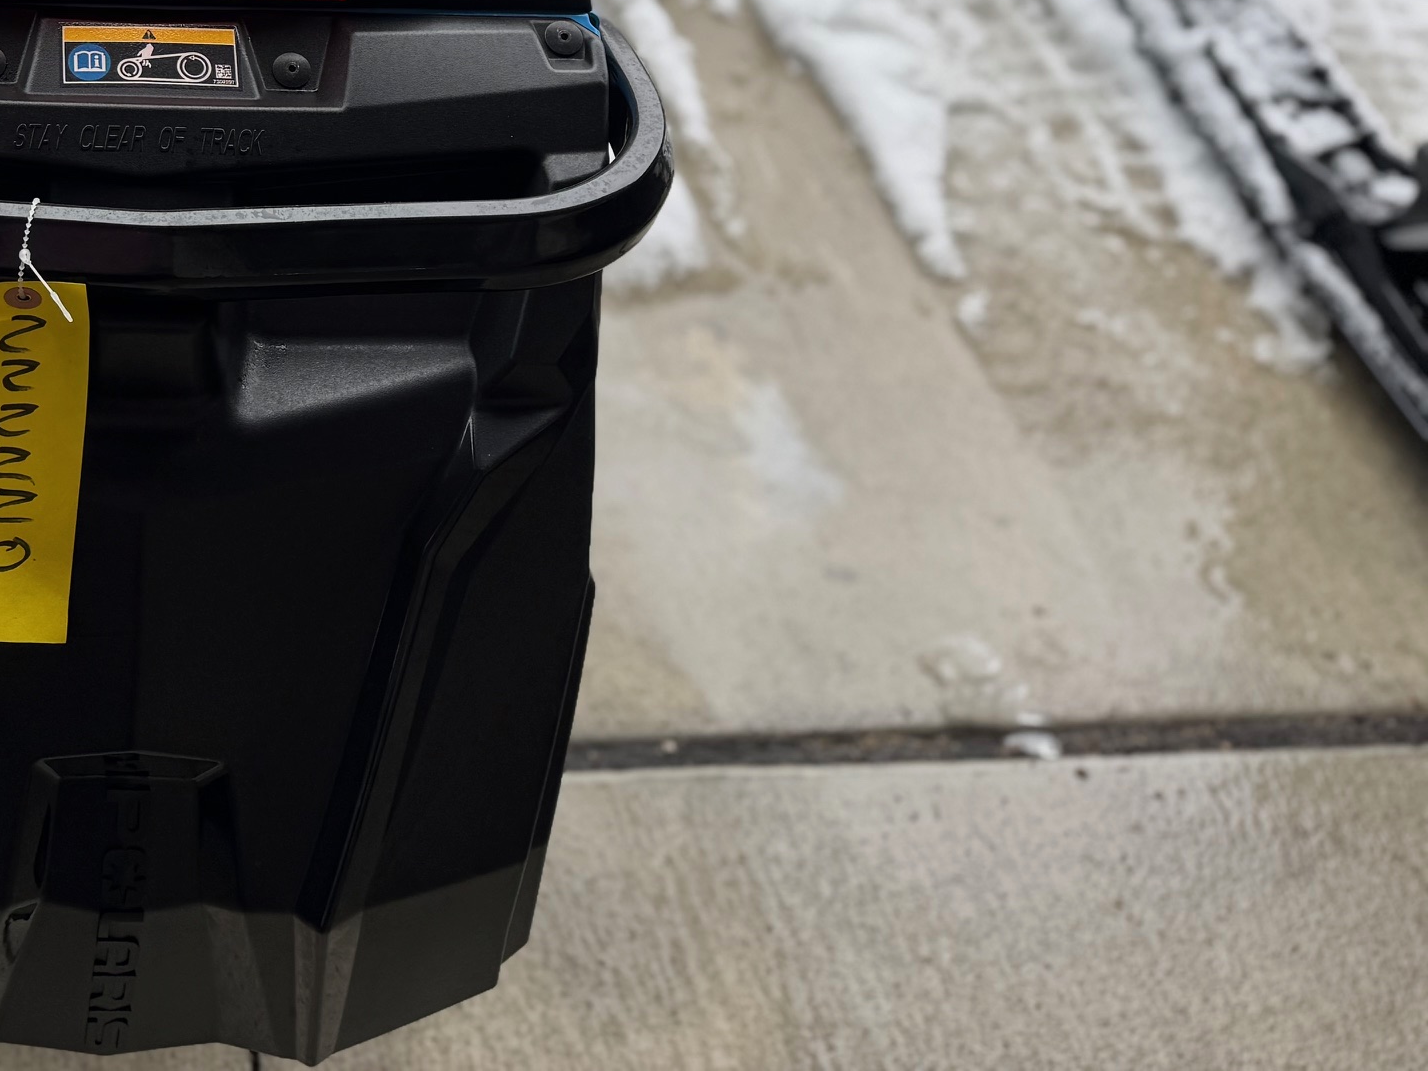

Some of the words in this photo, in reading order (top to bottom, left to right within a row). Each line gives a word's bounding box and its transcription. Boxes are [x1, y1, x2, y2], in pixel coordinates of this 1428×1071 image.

[13, 123, 68, 150] STAY
[78, 124, 147, 153] CLEAR
[158, 126, 187, 153] OF
[200, 127, 266, 156] TRACK
[84, 784, 152, 1050] POLARIS
